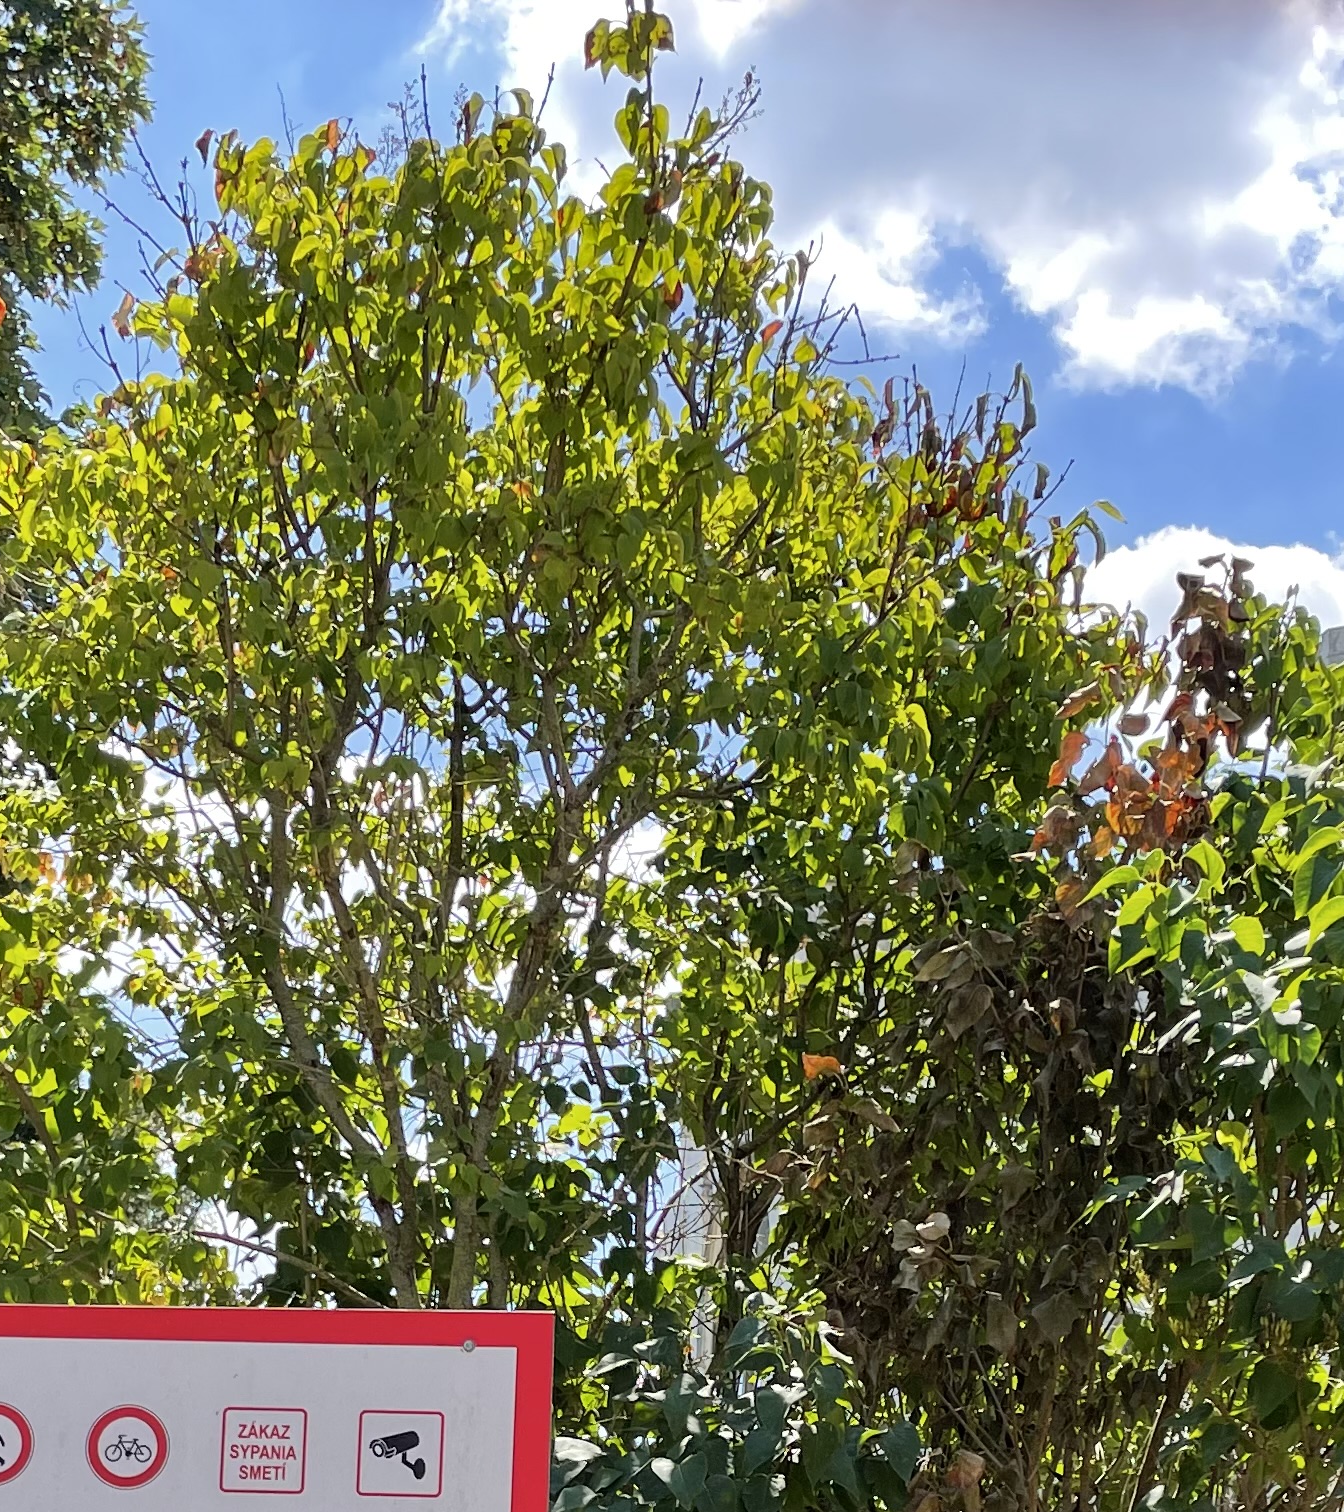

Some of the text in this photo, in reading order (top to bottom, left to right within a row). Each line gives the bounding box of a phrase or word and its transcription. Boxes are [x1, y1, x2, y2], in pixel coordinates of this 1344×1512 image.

[237, 1420, 291, 1440] ZÁKAZ
[229, 1444, 297, 1461] SYPANIA
[238, 1462, 287, 1481] SMETÍ
